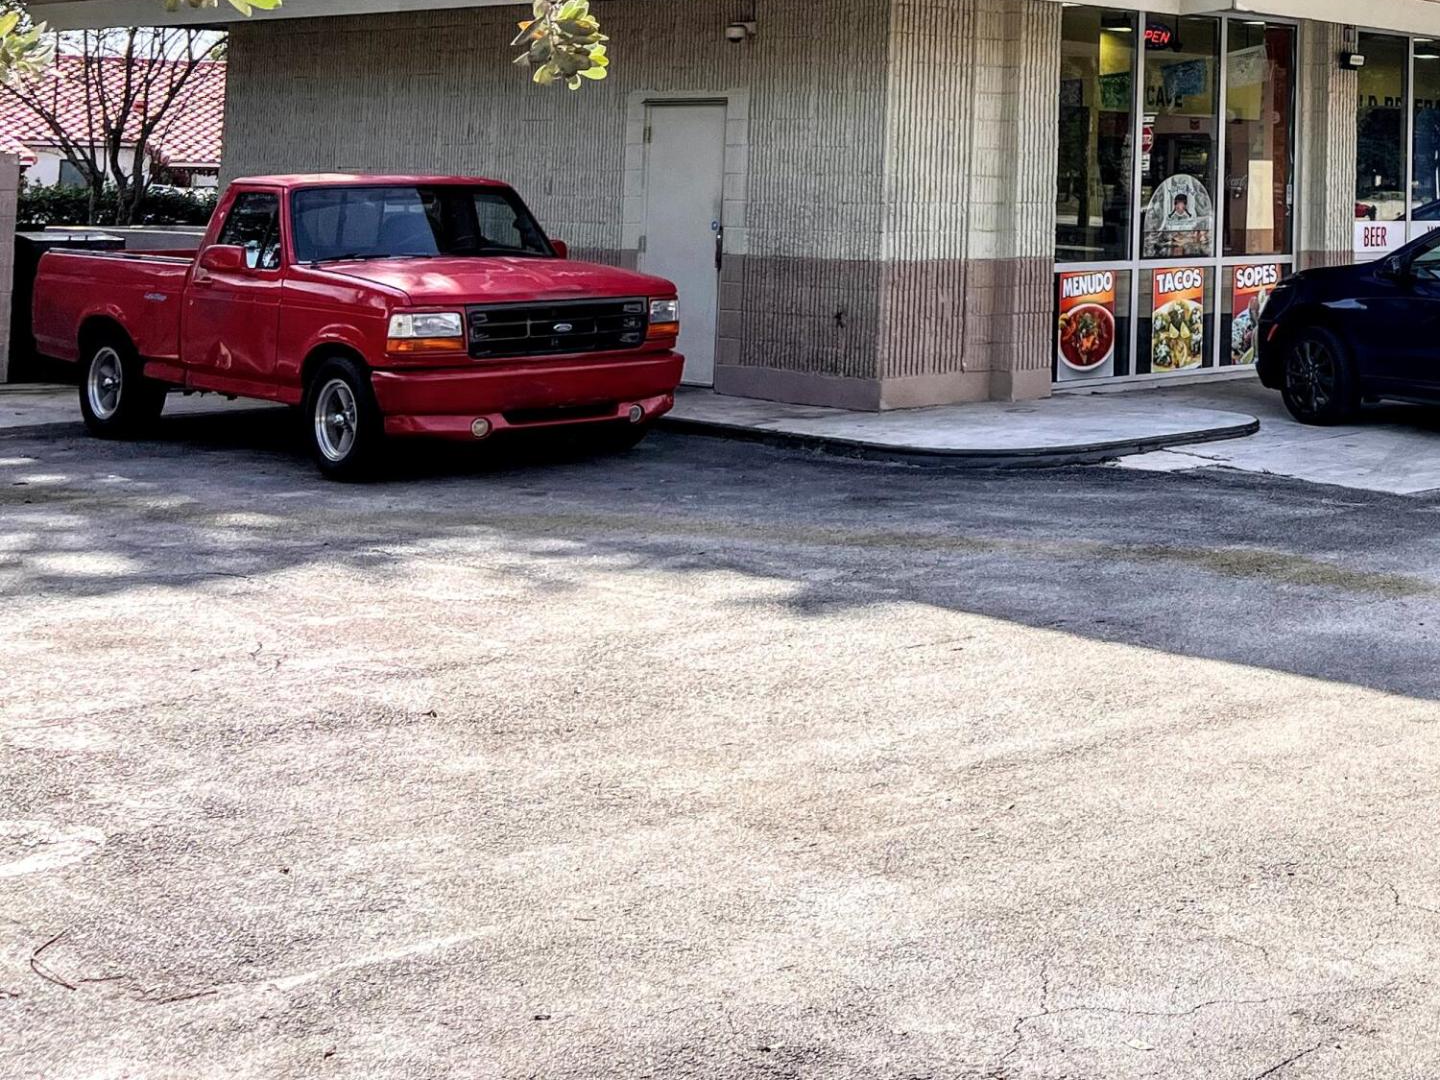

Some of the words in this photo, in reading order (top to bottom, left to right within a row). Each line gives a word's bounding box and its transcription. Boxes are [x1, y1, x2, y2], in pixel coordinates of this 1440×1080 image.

[1144, 30, 1170, 43] PEN
[1364, 226, 1387, 247] BEER
[1062, 271, 1113, 298] MENUDO
[1156, 269, 1202, 294] TACOS
[1236, 264, 1278, 289] SOPES
